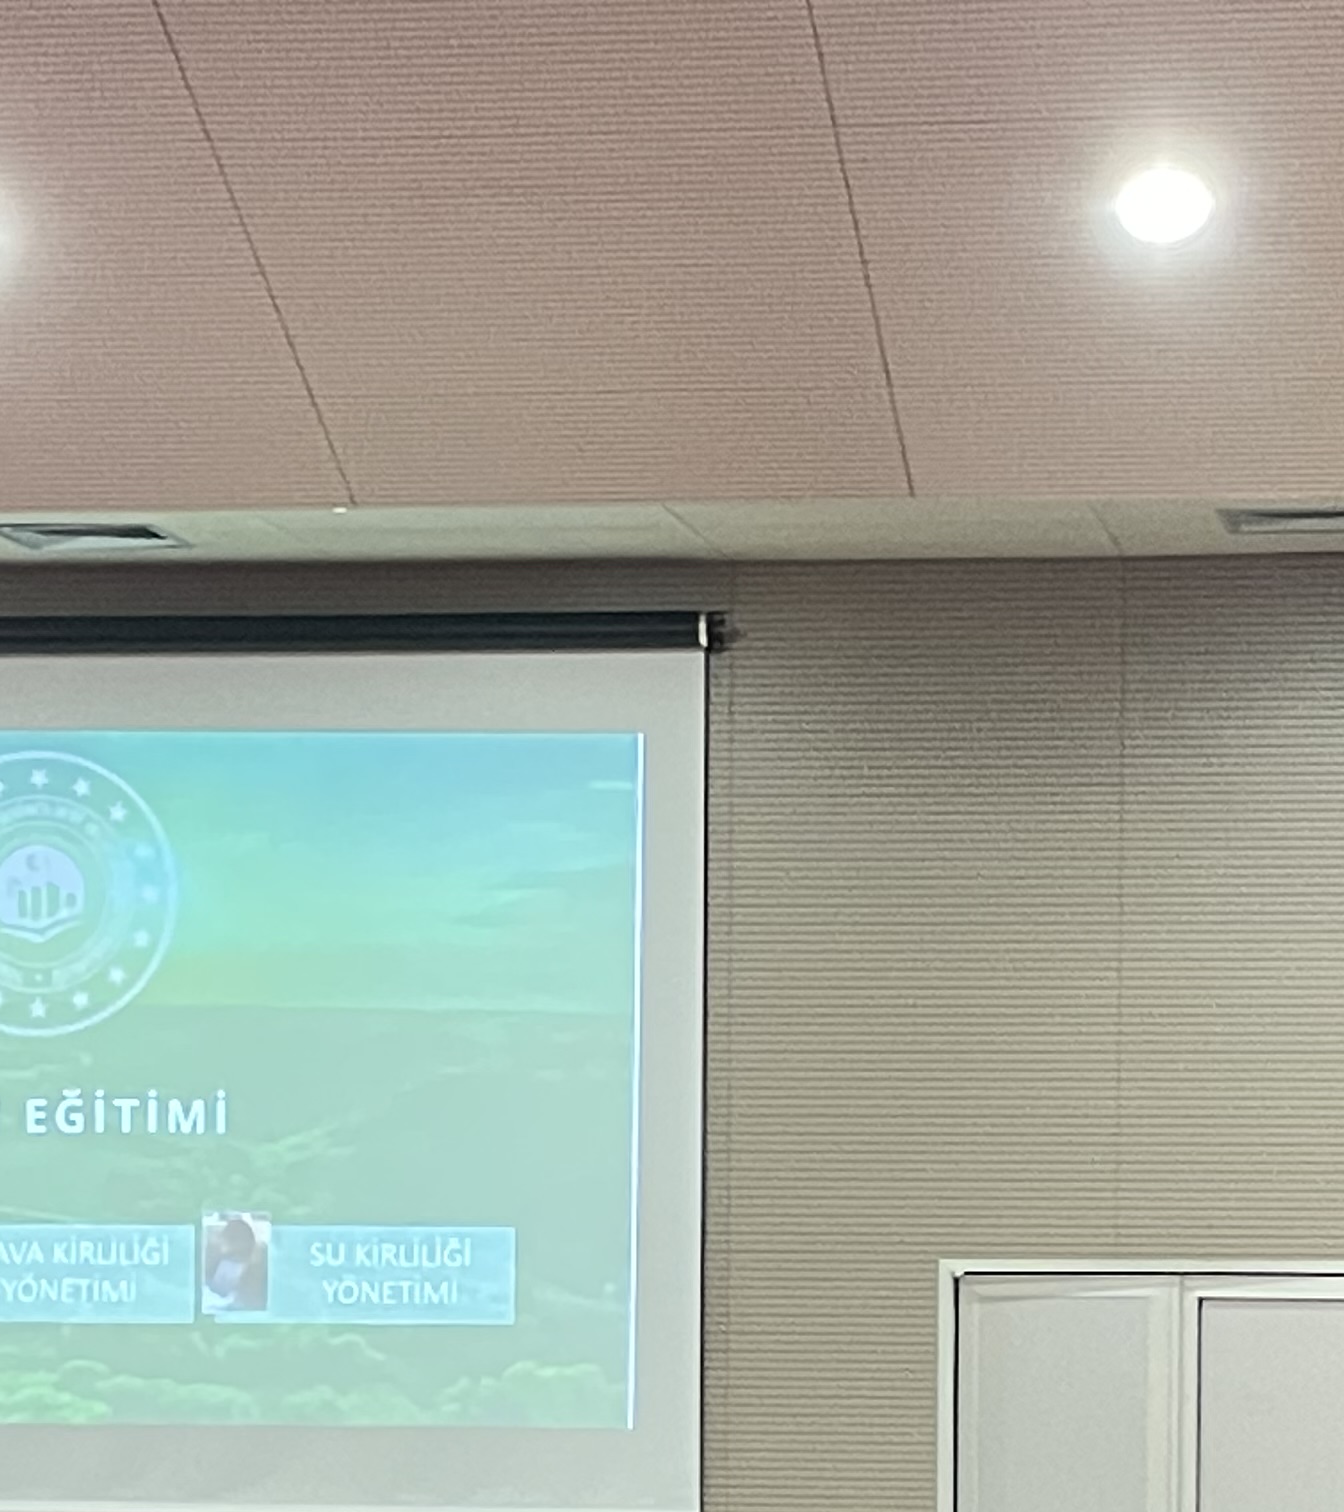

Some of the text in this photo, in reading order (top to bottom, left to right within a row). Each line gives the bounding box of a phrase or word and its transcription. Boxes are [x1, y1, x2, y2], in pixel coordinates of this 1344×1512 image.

[25, 1088, 227, 1134] EĞİTİMİ
[52, 1235, 169, 1266] KİRLİLİĞİ
[309, 1236, 471, 1268] SU KİRLİLİĞİ
[0, 1272, 137, 1303] YÖNETİMİ
[321, 1274, 457, 1305] YÖNETİMİ
